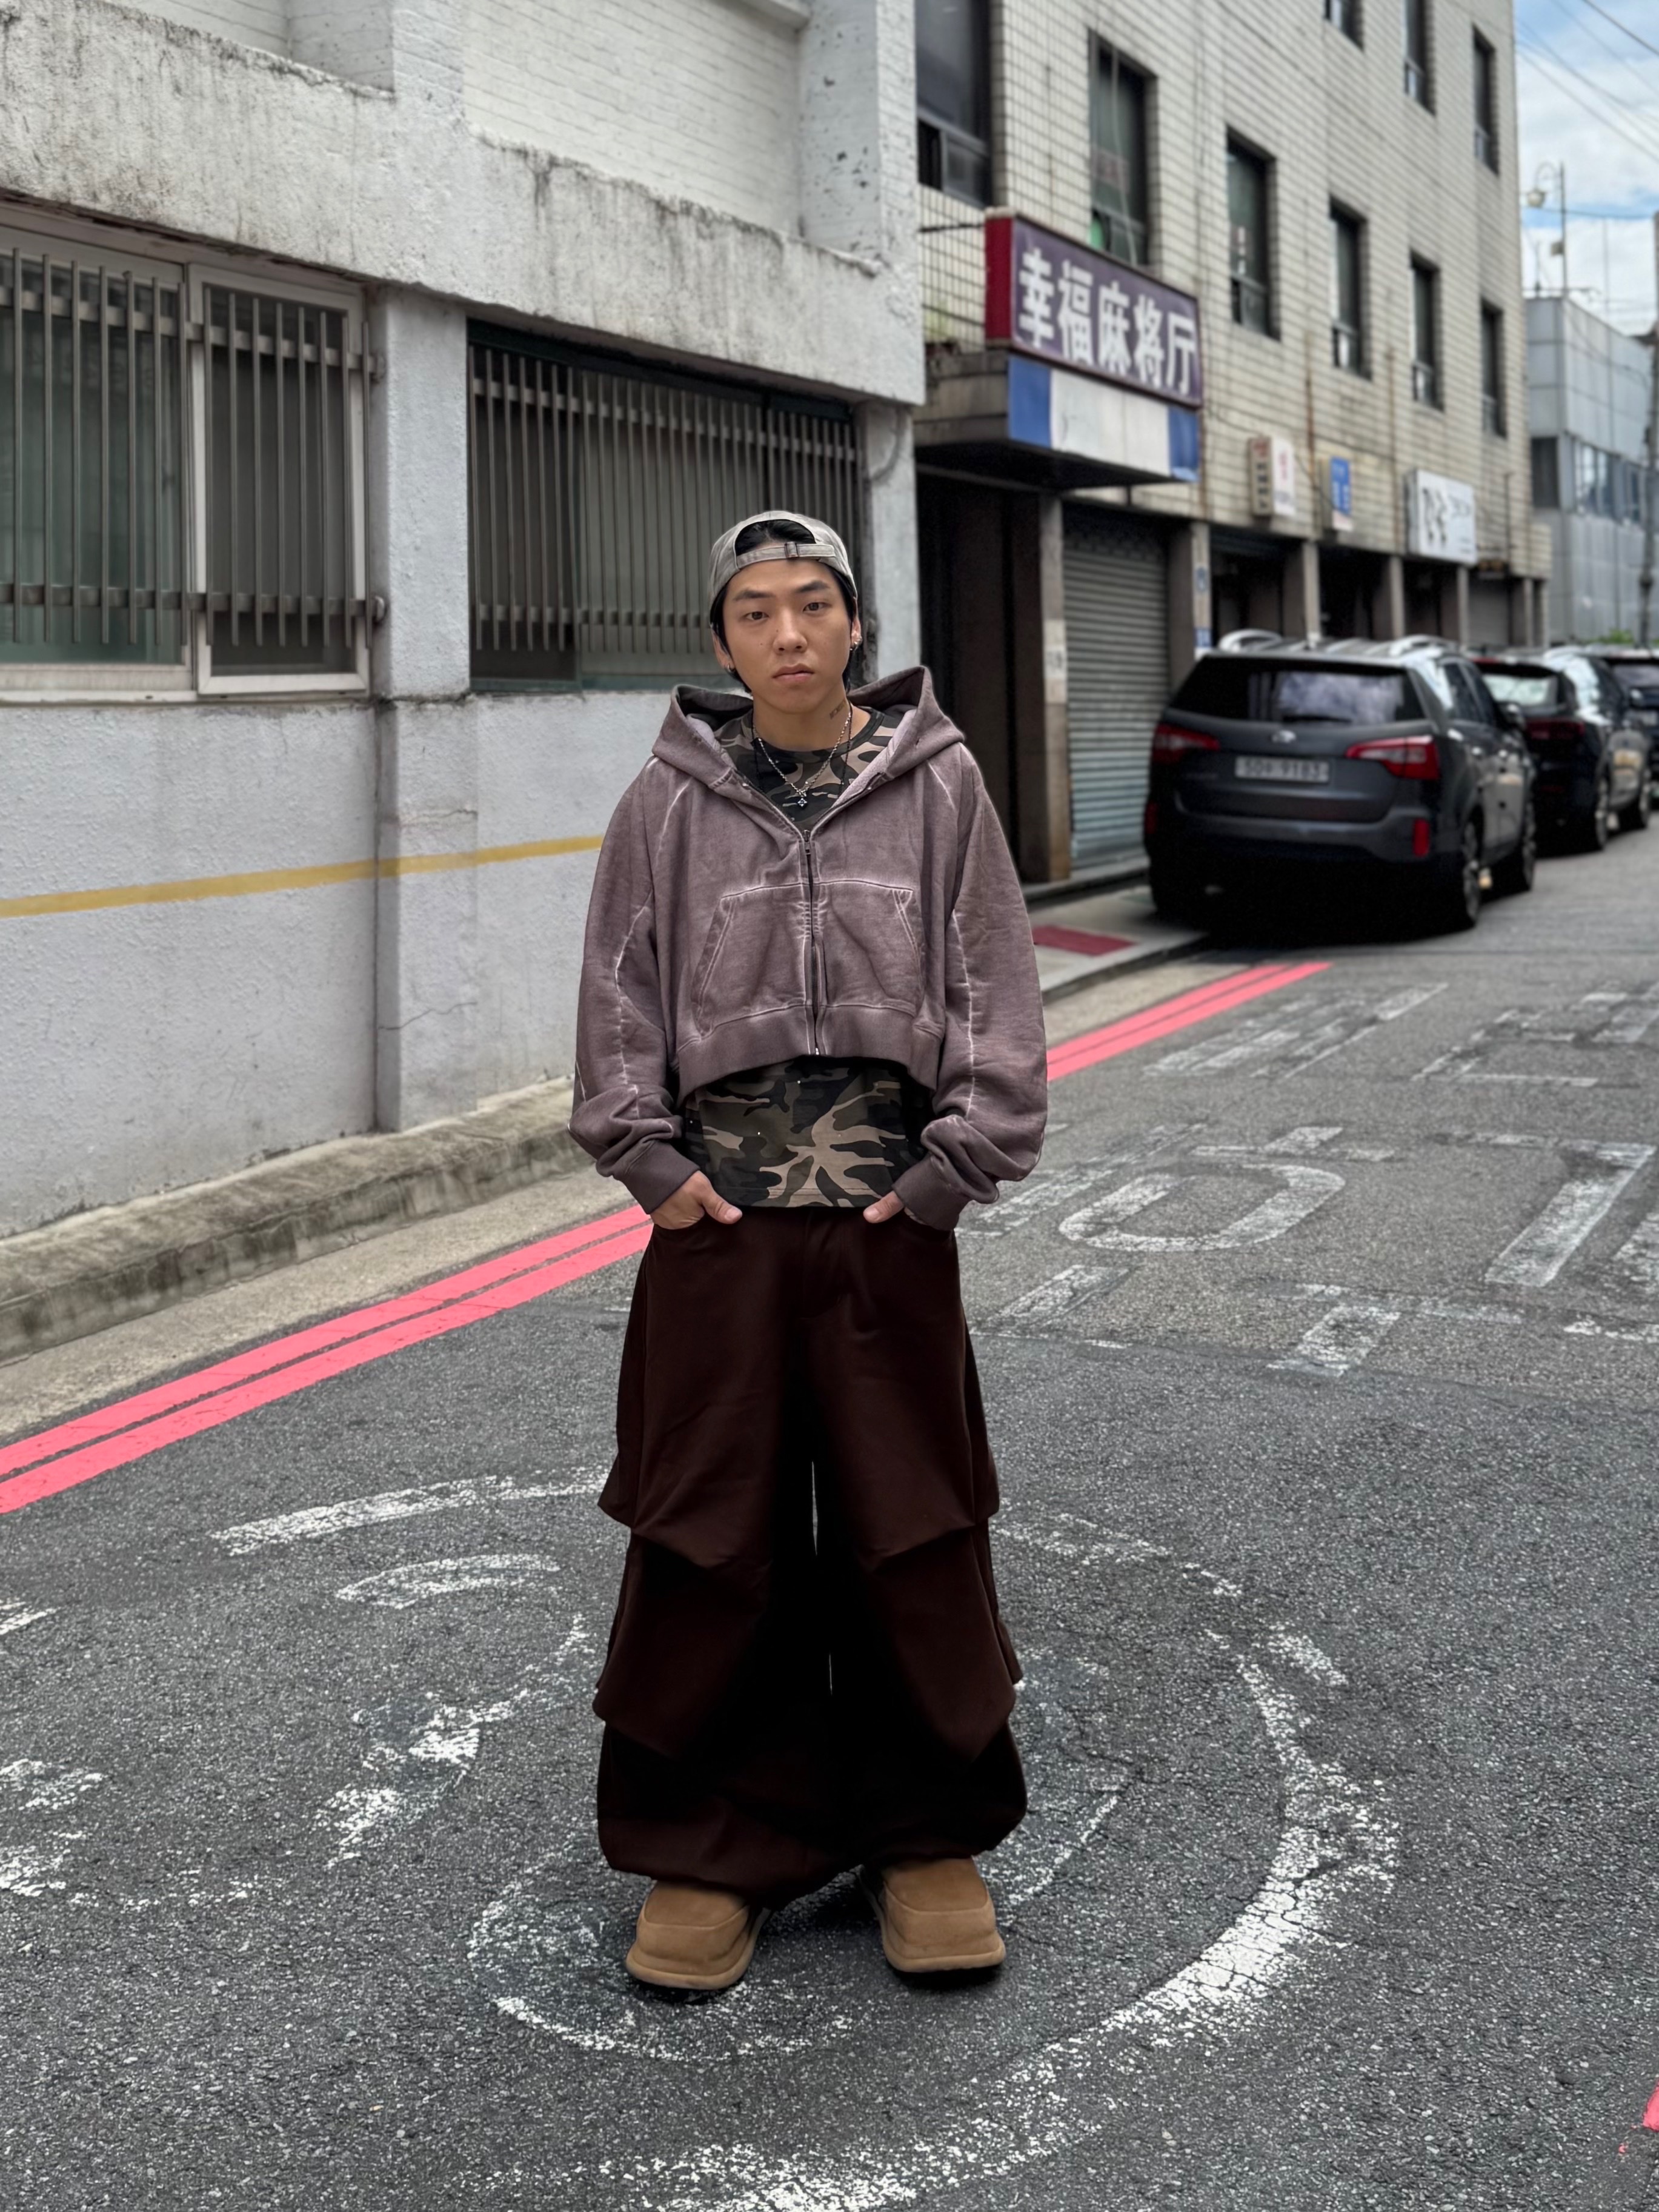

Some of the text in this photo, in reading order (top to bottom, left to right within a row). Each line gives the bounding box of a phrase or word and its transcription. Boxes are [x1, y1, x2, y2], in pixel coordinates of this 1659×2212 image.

[1019, 247, 1196, 395] 幸福麻将厅
